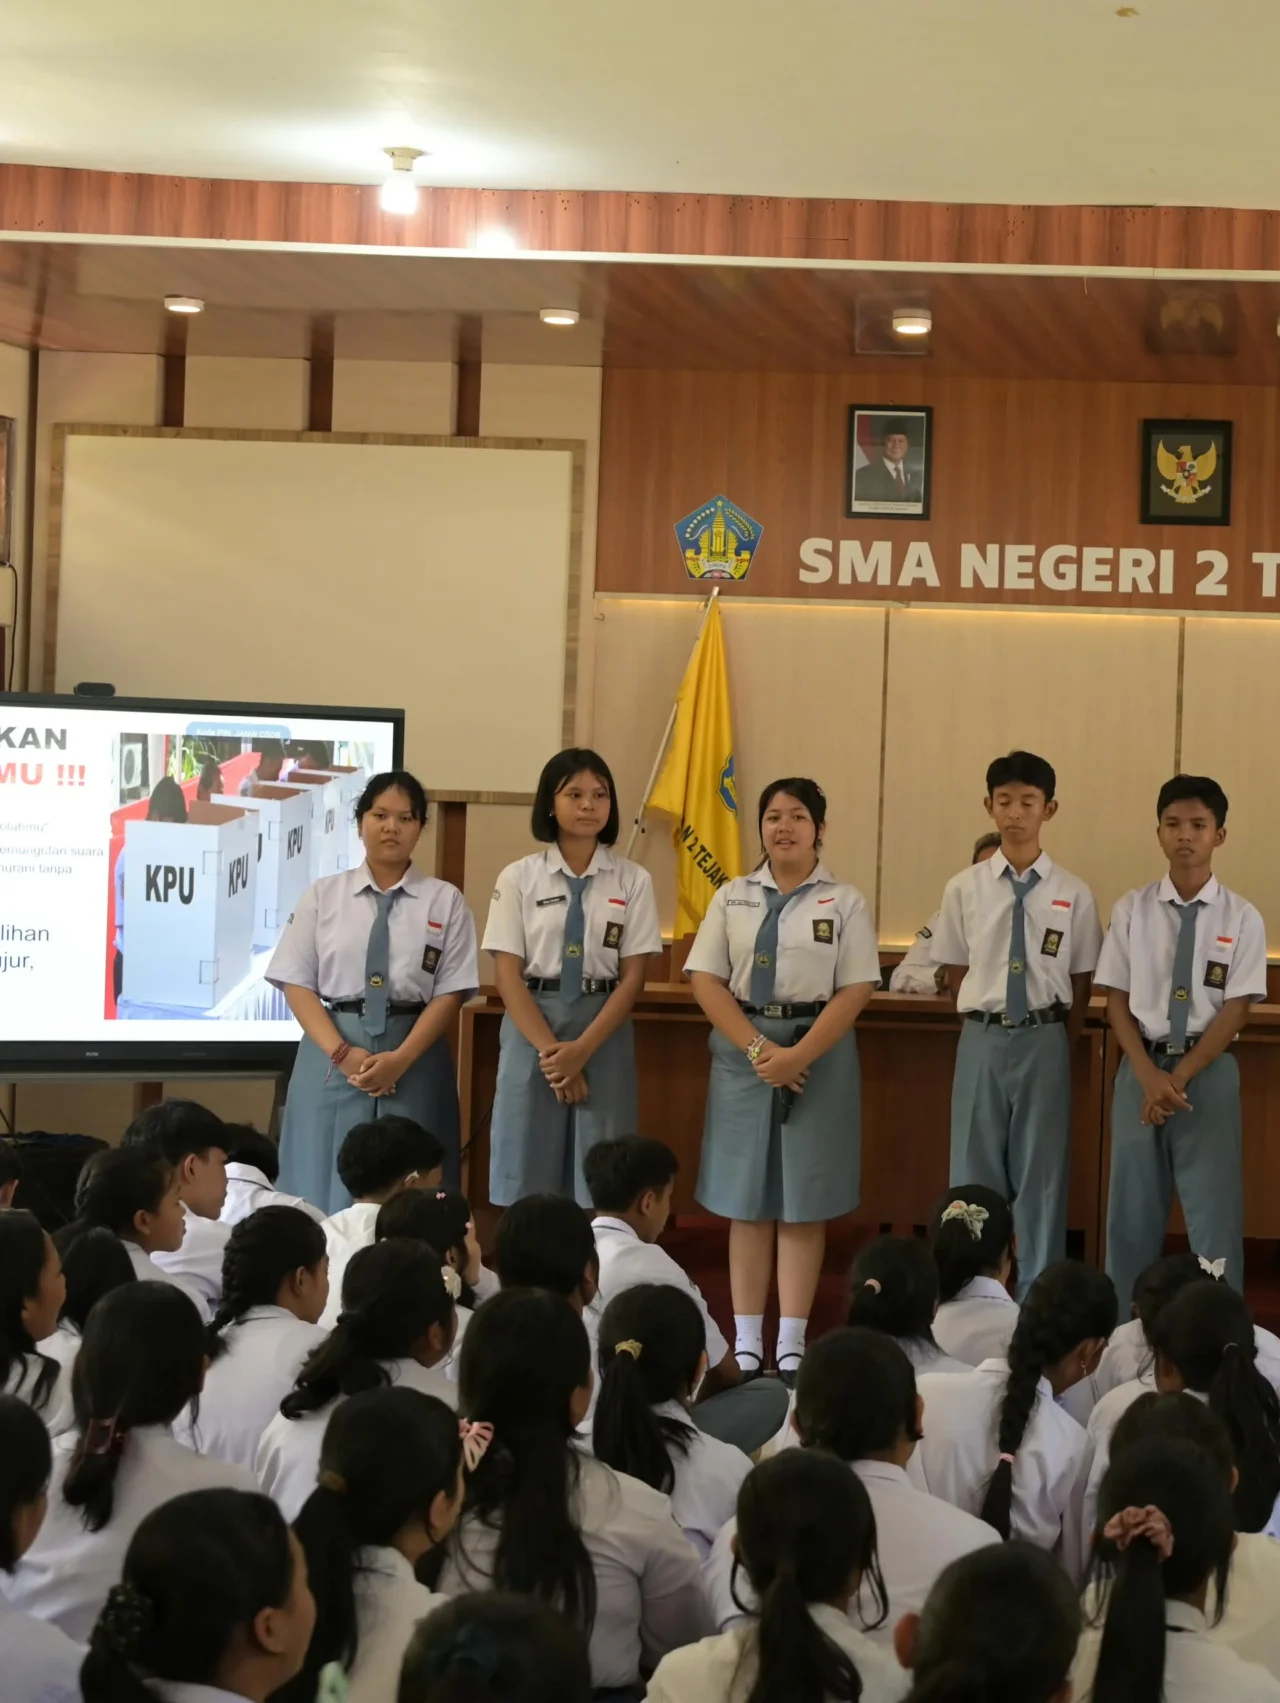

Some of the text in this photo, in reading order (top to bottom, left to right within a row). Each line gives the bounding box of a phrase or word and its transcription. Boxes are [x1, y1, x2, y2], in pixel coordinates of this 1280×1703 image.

[799, 537, 940, 587] SMA
[960, 543, 1174, 594] NEGERI
[1195, 549, 1229, 596] 2
[57, 764, 86, 786] !!!
[70, 847, 104, 856] suara
[287, 825, 303, 860] KPU
[39, 864, 73, 876] tanpa
[145, 864, 195, 905] KPU
[228, 853, 249, 897] KPU
